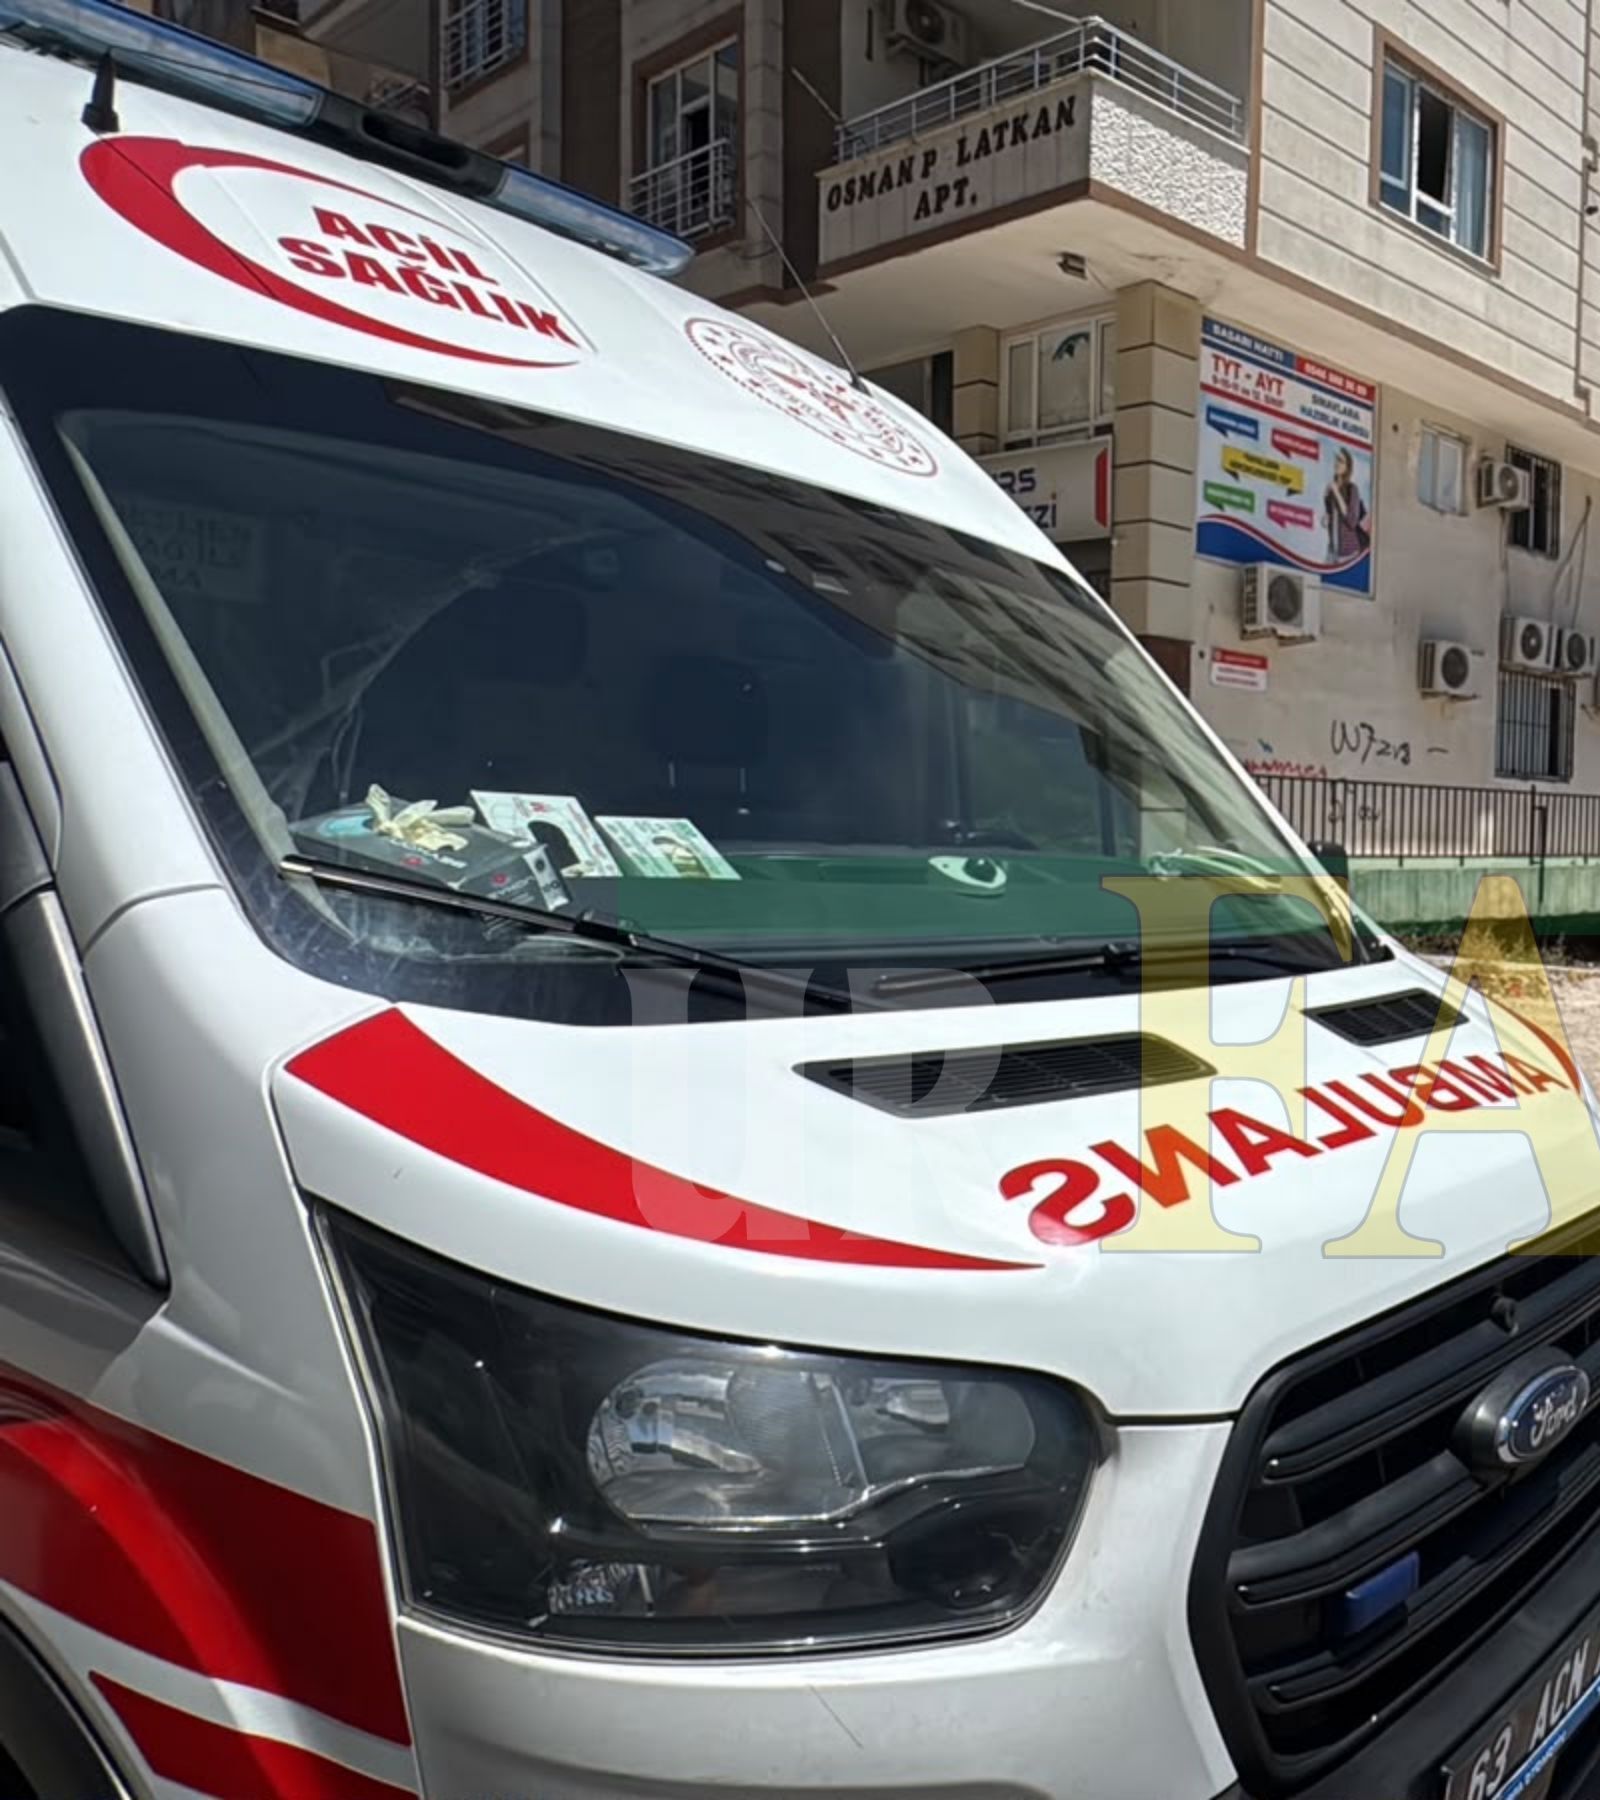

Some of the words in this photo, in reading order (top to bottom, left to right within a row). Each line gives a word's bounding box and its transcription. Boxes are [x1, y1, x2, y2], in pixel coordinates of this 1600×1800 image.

[826, 157, 914, 211] OSMAN
[956, 97, 1076, 168] LATKAN
[913, 178, 978, 221] APT.
[277, 237, 580, 348] SAĞLIK
[1212, 353, 1242, 380] TYT
[1256, 371, 1285, 396] AYT
[1529, 1386, 1579, 1447] Ford
[1467, 1725, 1513, 1800] 63
